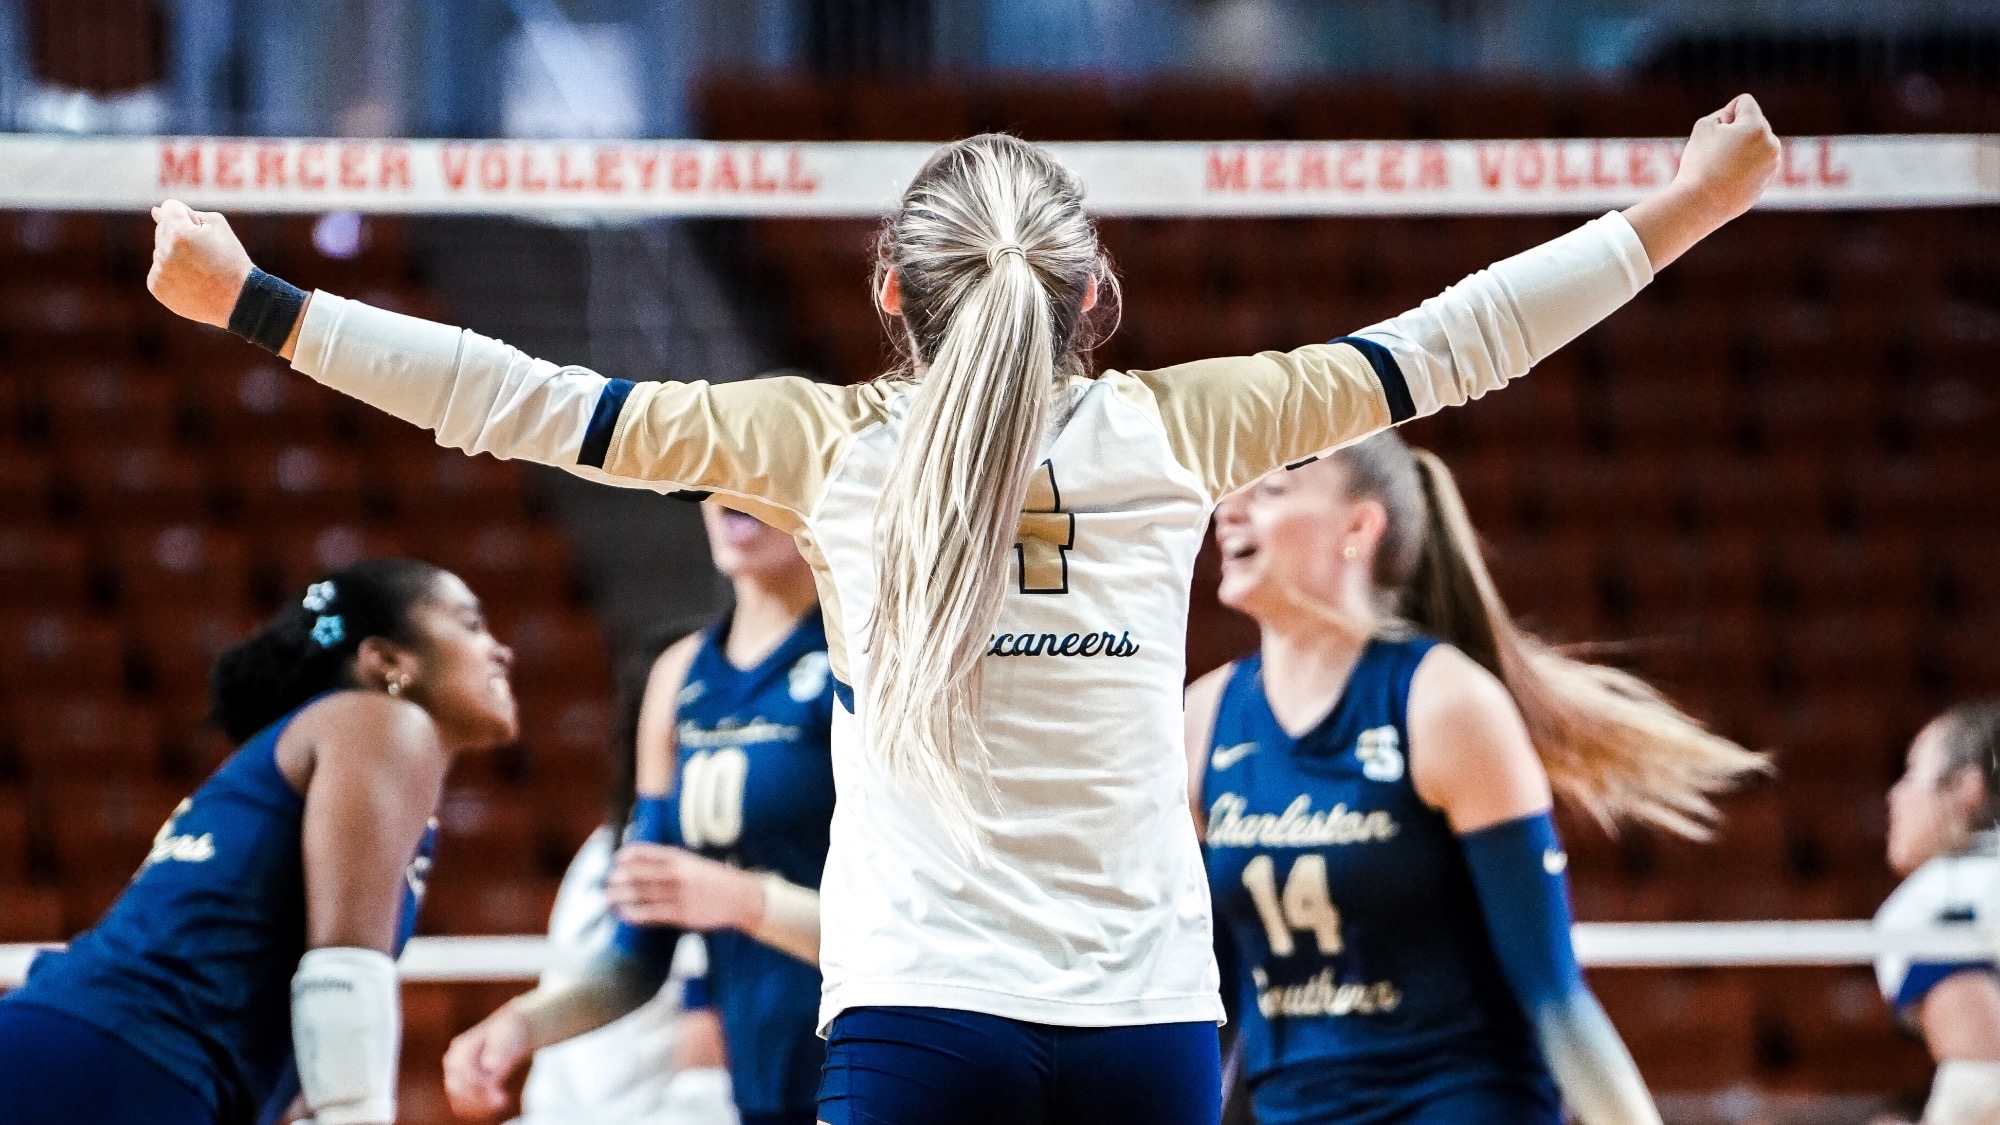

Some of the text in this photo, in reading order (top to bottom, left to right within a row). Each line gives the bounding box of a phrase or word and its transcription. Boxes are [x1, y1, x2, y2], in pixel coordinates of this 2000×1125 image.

[158, 141, 818, 192] MERCER VOLLEYBALL
[1206, 138, 1850, 190] MERCER VOLLELL
[987, 630, 1140, 657] caneers
[680, 749, 747, 848] 10
[1206, 792, 1397, 848] Charleston
[1241, 855, 1343, 956] 14
